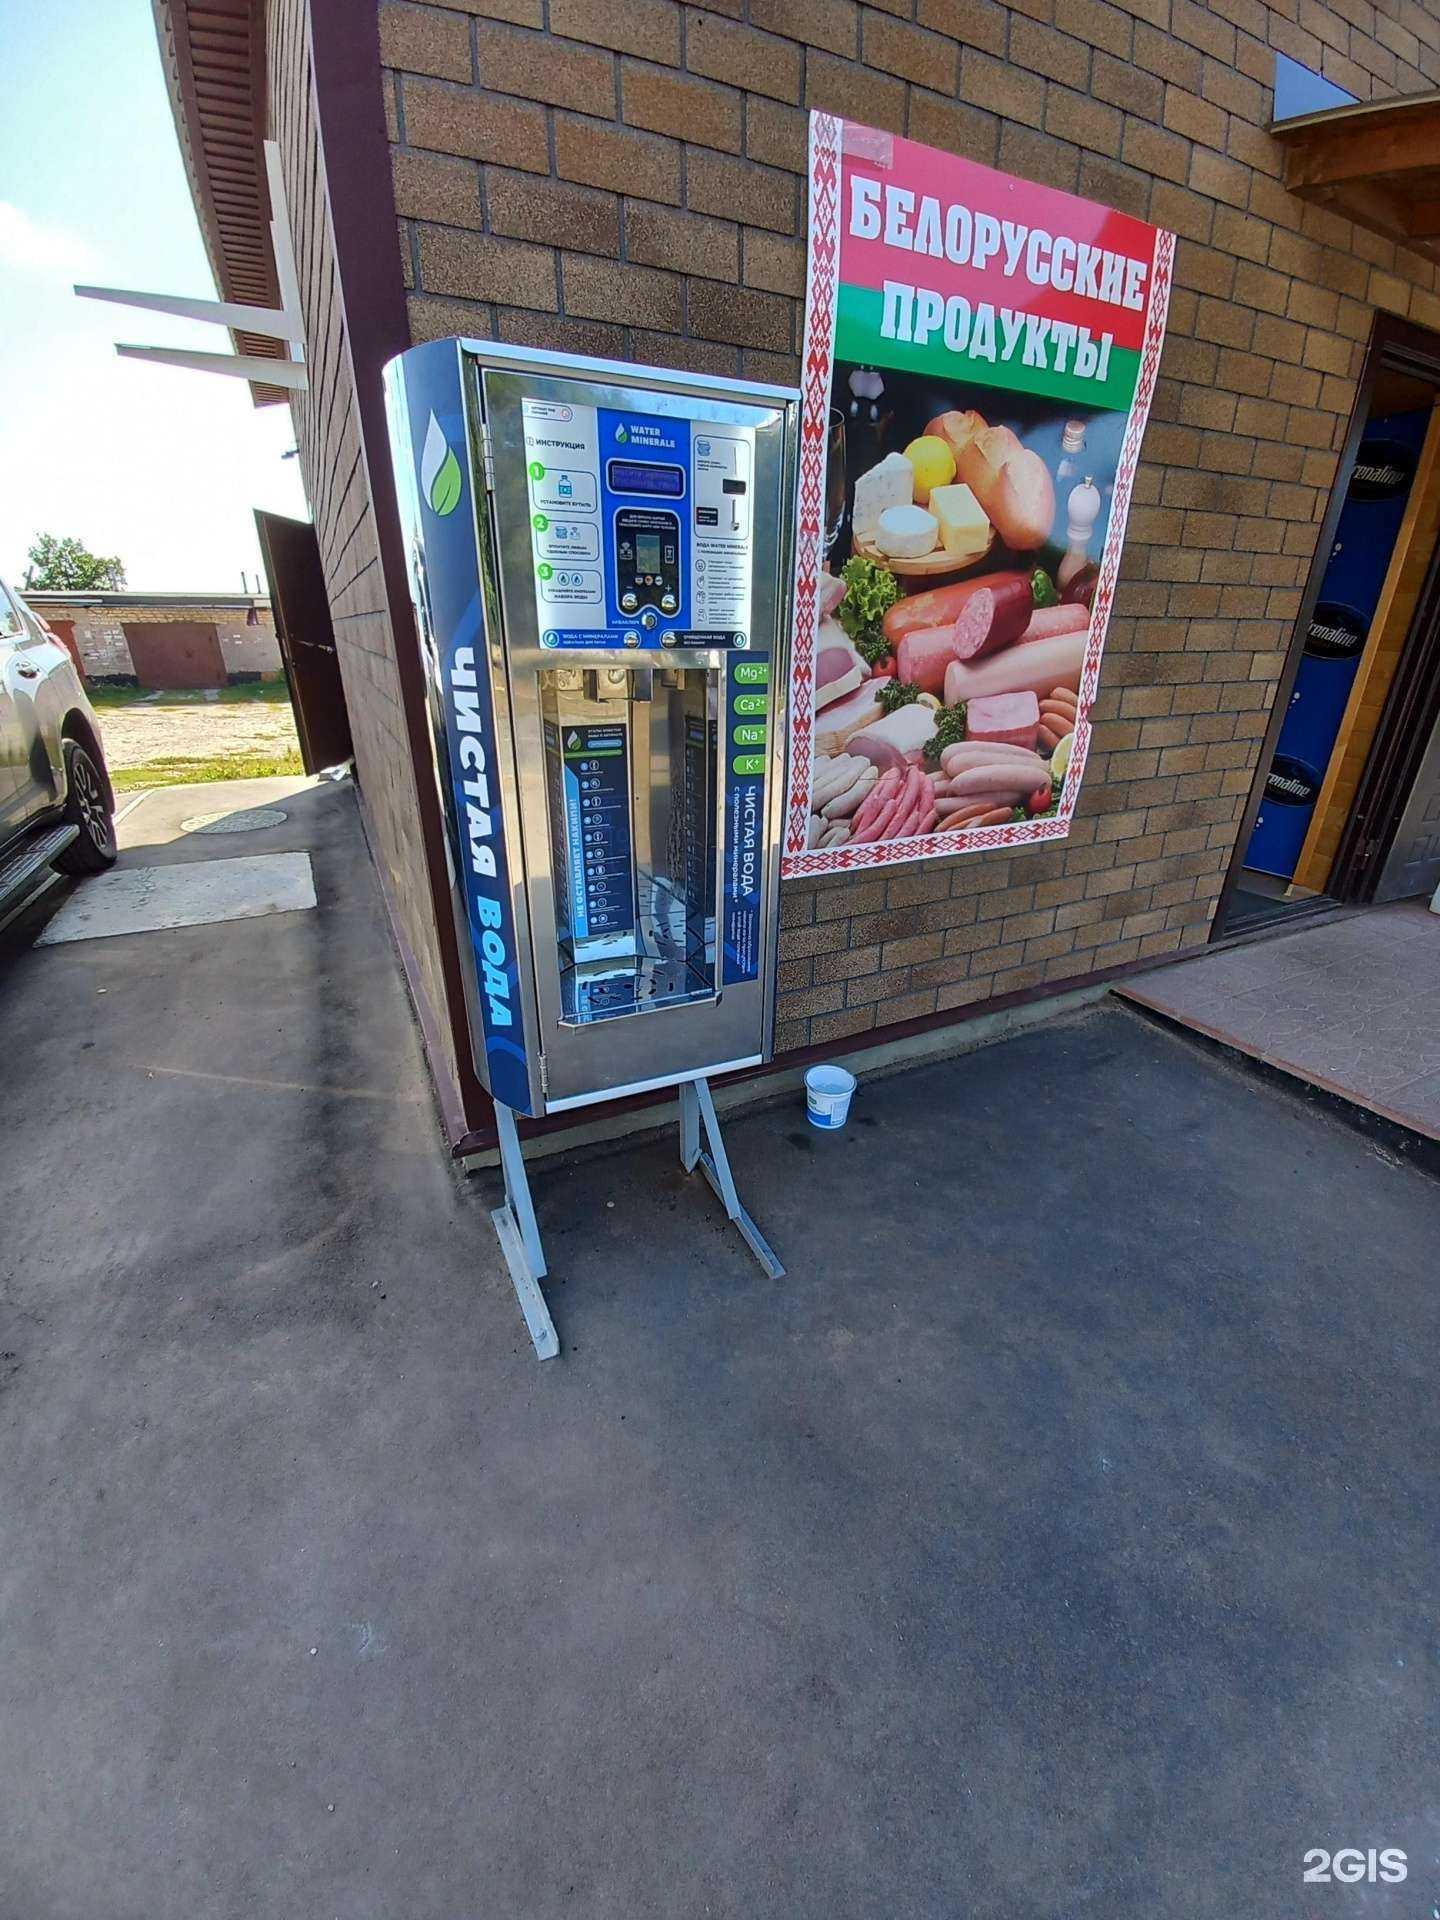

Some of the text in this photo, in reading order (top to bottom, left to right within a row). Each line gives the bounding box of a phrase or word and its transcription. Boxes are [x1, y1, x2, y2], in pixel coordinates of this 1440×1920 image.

[849, 174, 1148, 312] БЕЛОРУССКИЕ
[880, 279, 1114, 382] ПРОДУКТЫ
[535, 439, 585, 450] ИНСТРУКЦИЯ
[630, 425, 661, 437] WATER
[631, 435, 676, 448] MINERALE
[450, 646, 513, 1028] ЧИСТАЯ ВОДА
[742, 785, 756, 897] ЧИСТАЯ ВОДА
[573, 847, 584, 904] ОСТАВЛЯЕТ
[576, 904, 585, 918] НЕ
